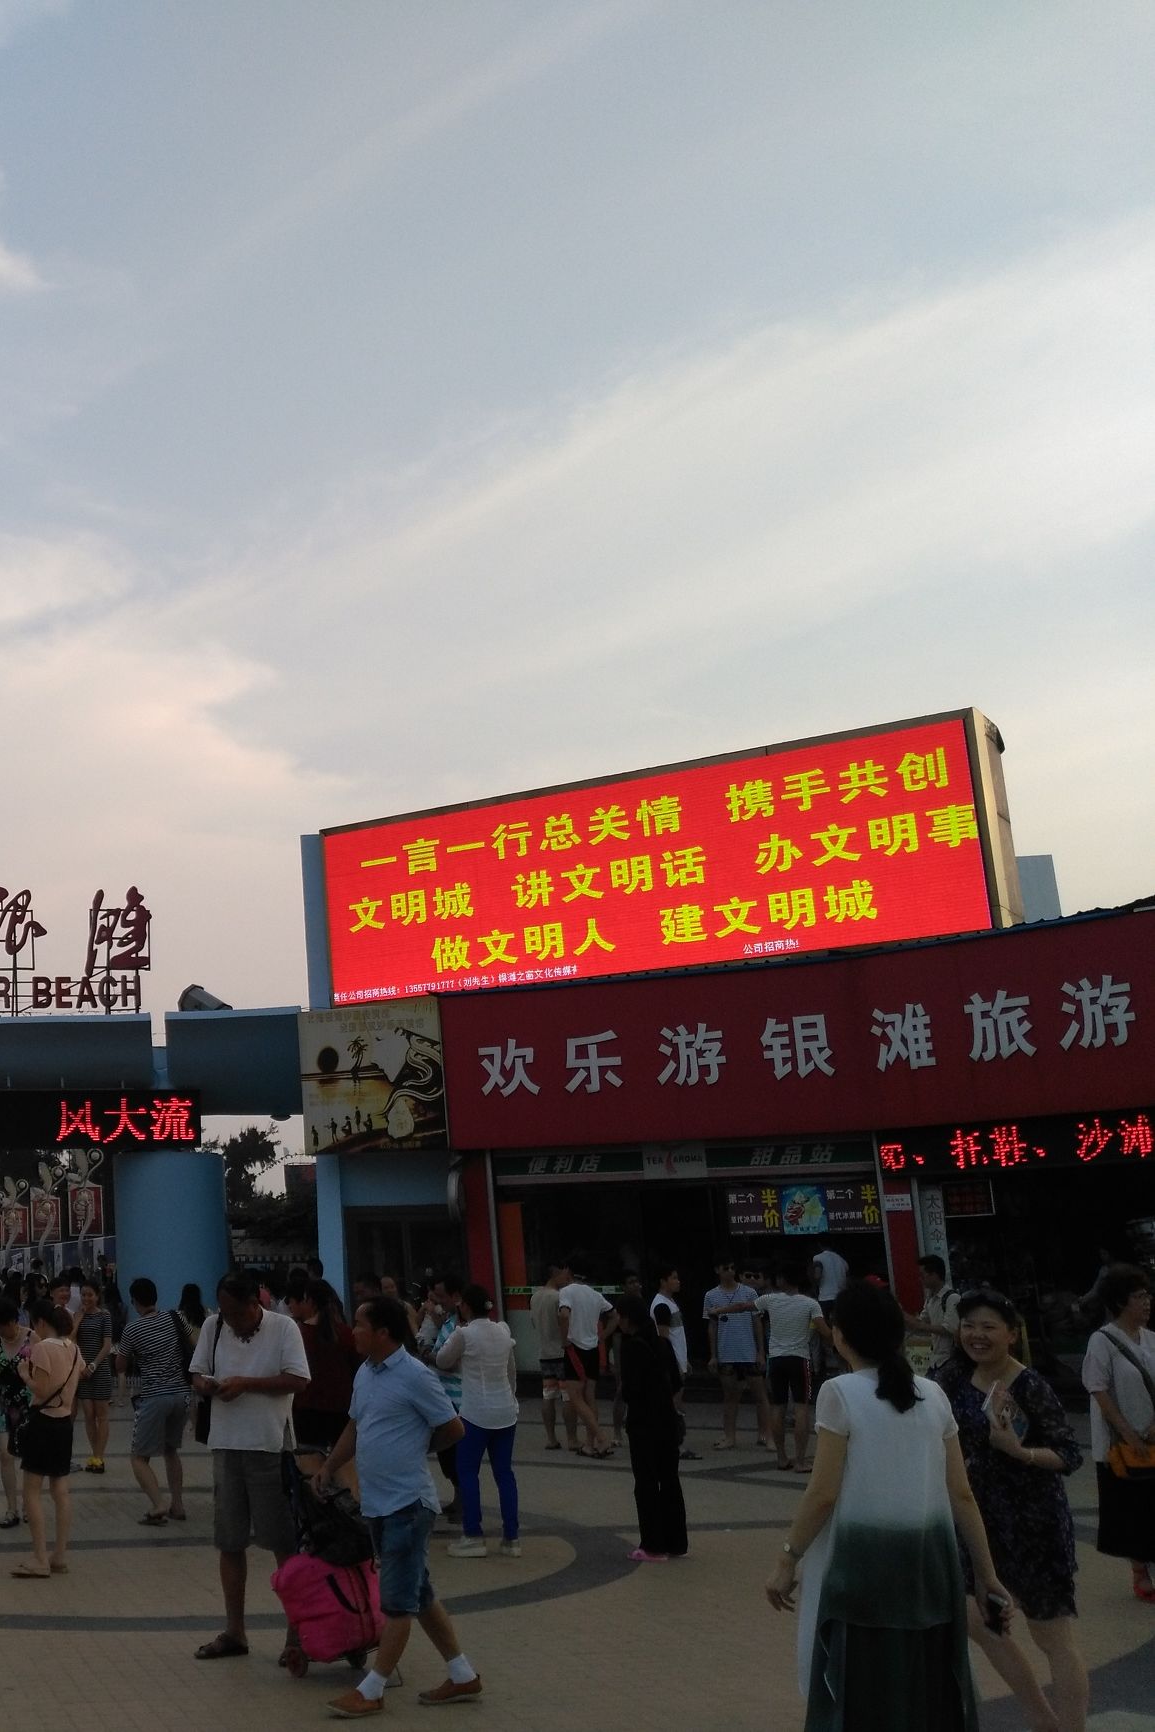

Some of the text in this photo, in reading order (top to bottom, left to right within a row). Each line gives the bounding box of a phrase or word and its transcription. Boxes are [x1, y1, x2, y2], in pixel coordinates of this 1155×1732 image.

[360, 747, 949, 868] 一言一行总关情 携手共创
[348, 803, 979, 933] 文明城 讲文明话 办文明事
[430, 879, 878, 974] 做文明人 建文明城
[32, 974, 142, 1010] BEACH
[478, 974, 1137, 1099] 欢乐游银滩旅游
[56, 1097, 195, 1144] 风大流
[527, 1152, 602, 1175] 便利店
[646, 1156, 664, 1165] TEA
[749, 1145, 835, 1166] 甜品站
[760, 1188, 780, 1229] 半价
[861, 1183, 880, 1225] 半价
